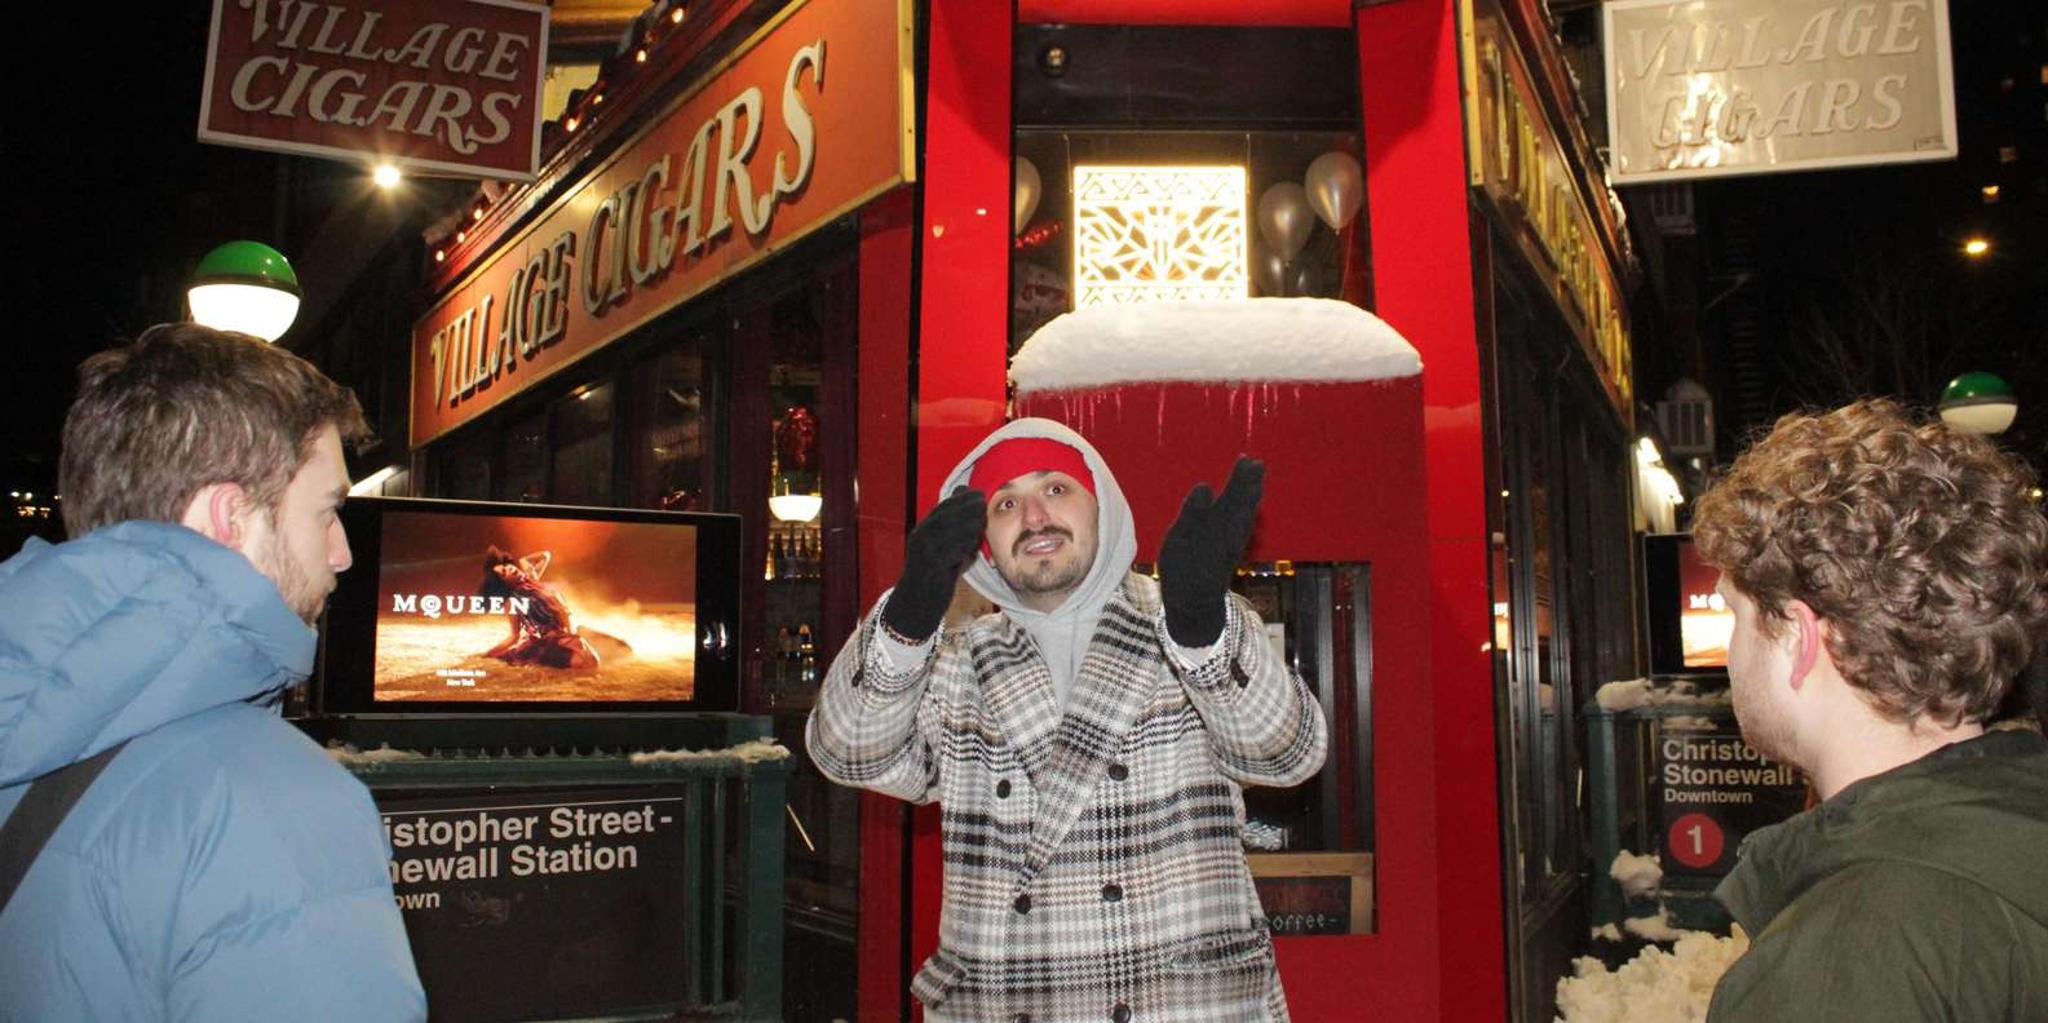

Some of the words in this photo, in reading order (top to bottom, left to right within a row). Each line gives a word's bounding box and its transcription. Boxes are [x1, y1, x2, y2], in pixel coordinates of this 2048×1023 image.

[239, 0, 529, 81] VILLAGE
[1629, 0, 1927, 80] VILLAGE
[231, 55, 522, 155] CIGARS
[1652, 74, 1908, 148] CIGARS
[430, 231, 576, 411] VILLAGE
[582, 39, 826, 319] CIGARS
[1664, 763, 1793, 786] Stonewall
[1664, 788, 1753, 803] Downtown
[510, 841, 638, 876] Station
[1687, 824, 1702, 854] 1
